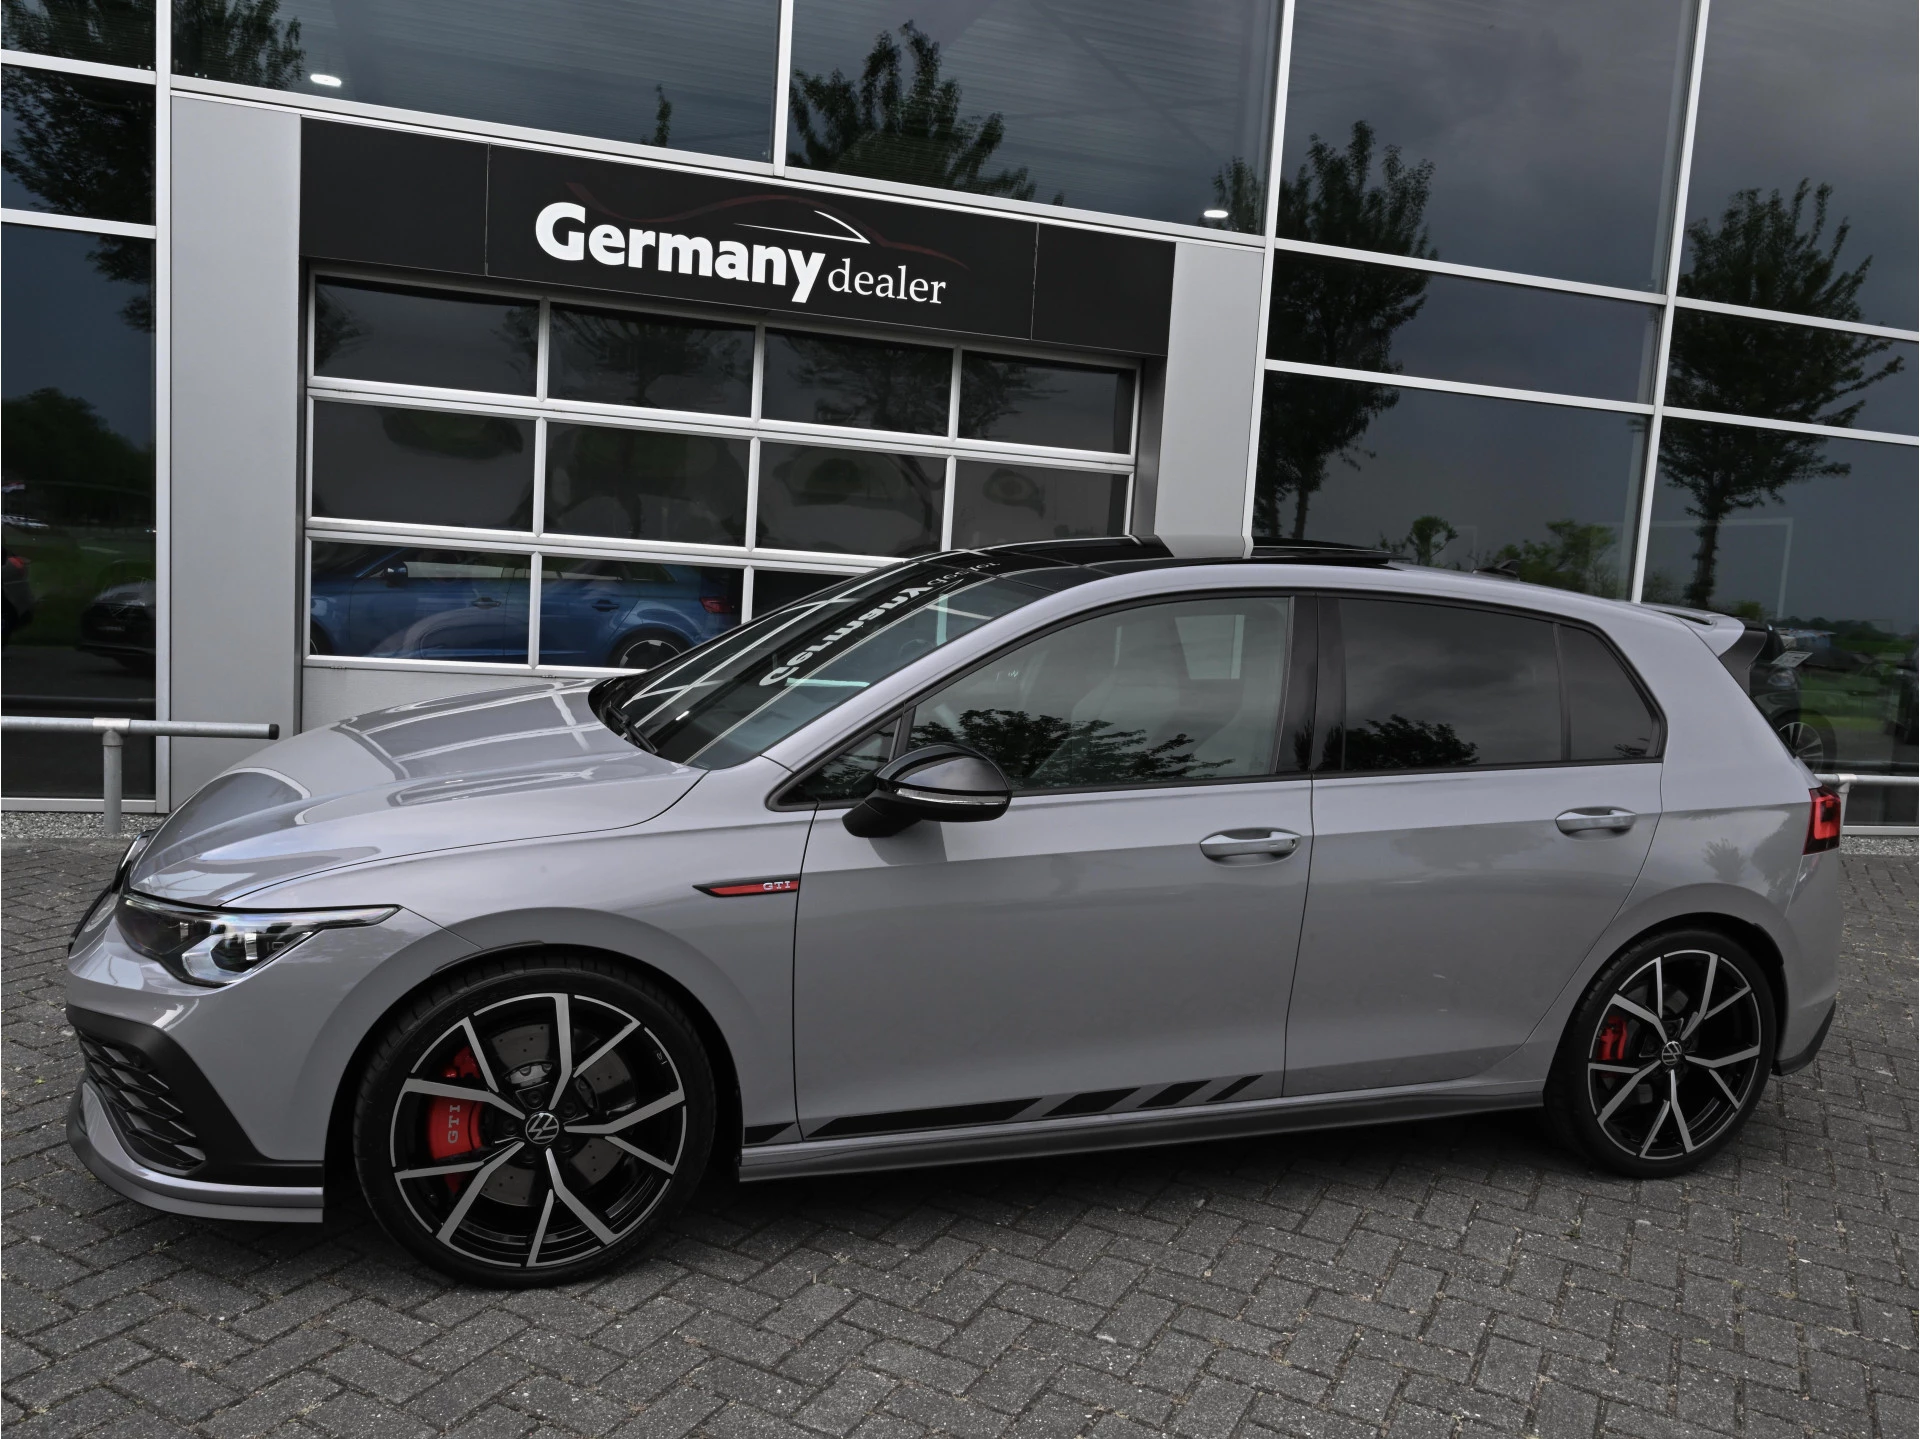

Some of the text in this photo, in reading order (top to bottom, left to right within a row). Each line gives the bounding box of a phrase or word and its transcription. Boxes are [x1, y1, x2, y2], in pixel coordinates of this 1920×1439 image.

[534, 201, 946, 304] Germany dealer
[762, 880, 791, 891] GTI
[447, 1104, 461, 1144] GTI
